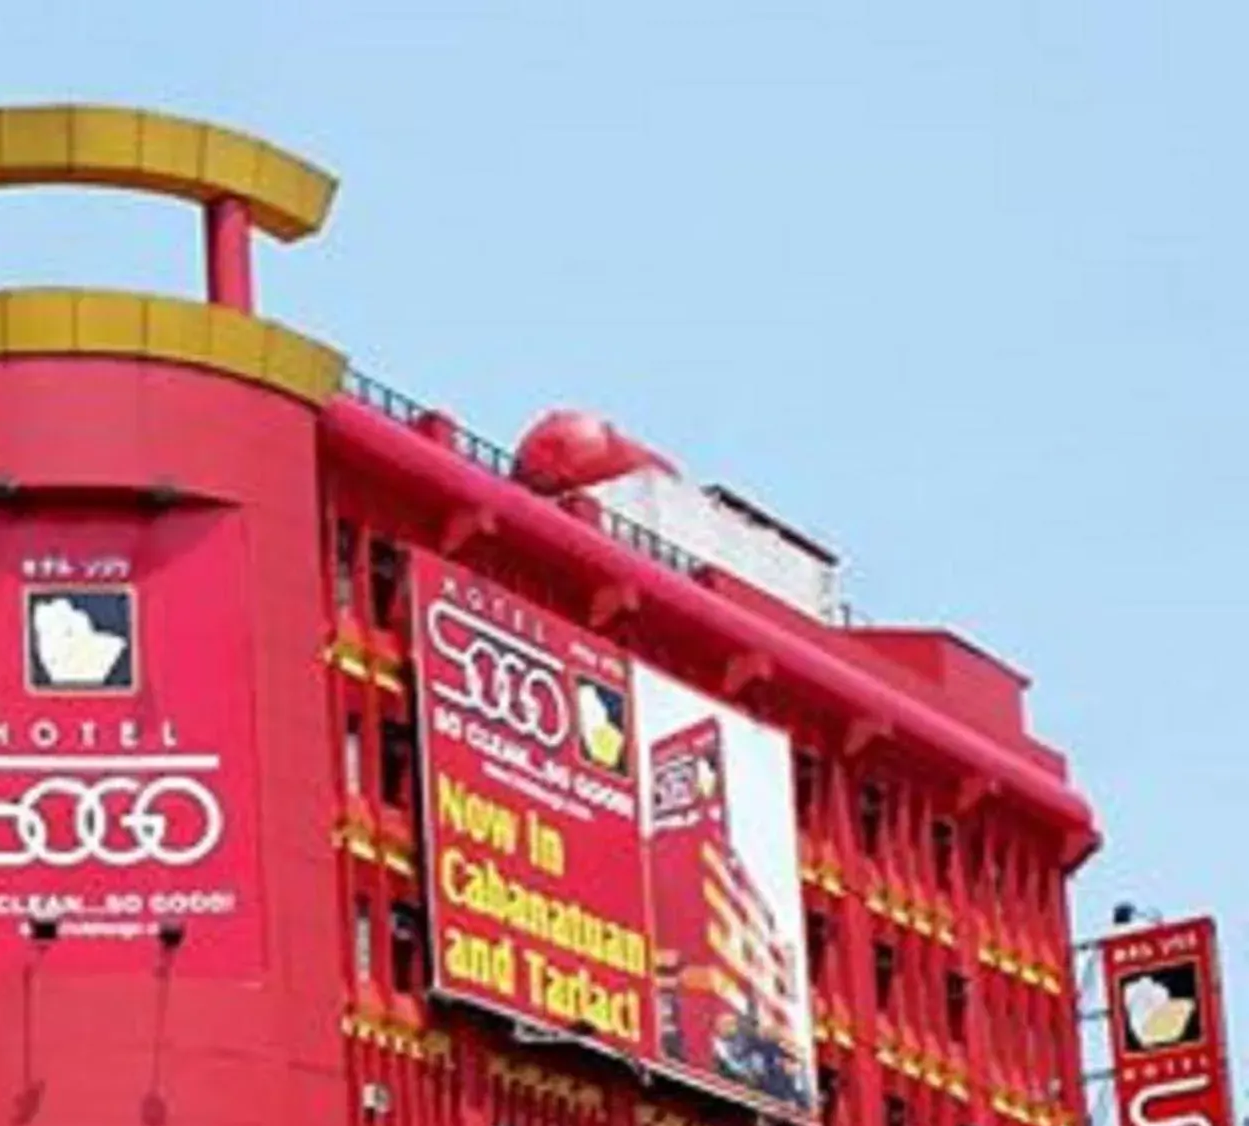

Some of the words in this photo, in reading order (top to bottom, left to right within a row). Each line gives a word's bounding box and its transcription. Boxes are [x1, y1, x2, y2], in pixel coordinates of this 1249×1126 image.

[427, 600, 570, 747] SOGO
[438, 771, 519, 855] Now
[441, 846, 646, 977] Cabanatuan
[444, 926, 515, 996] and
[522, 949, 641, 1043] Tarlac!
